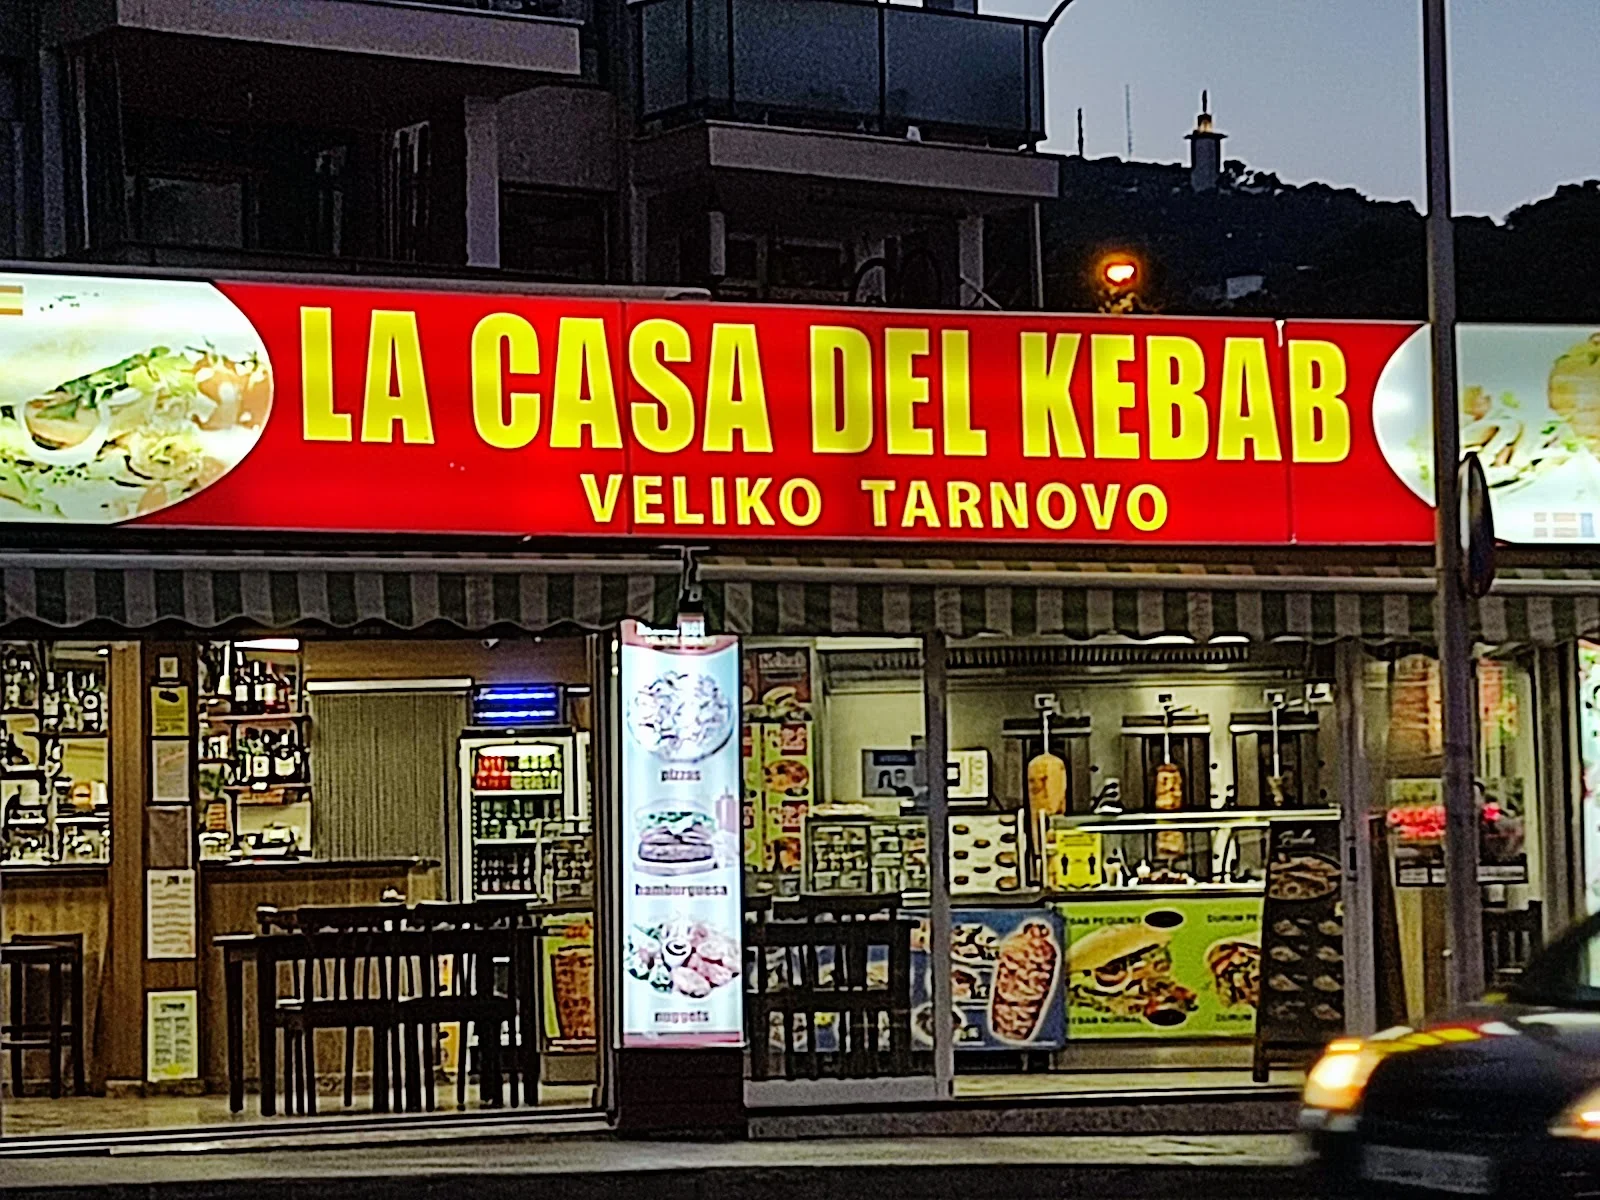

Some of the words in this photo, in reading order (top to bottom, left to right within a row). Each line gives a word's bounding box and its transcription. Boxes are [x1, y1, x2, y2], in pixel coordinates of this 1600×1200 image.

[299, 306, 435, 444] LA
[470, 311, 774, 454] CASA
[809, 325, 988, 456] DEL
[1020, 331, 1351, 464] KEBAB
[579, 473, 823, 527] VELIKO
[860, 478, 1169, 532] TARNOVO
[661, 767, 702, 782] pizzas
[634, 883, 728, 898] hamburguesa
[653, 1008, 710, 1024] nuggets
